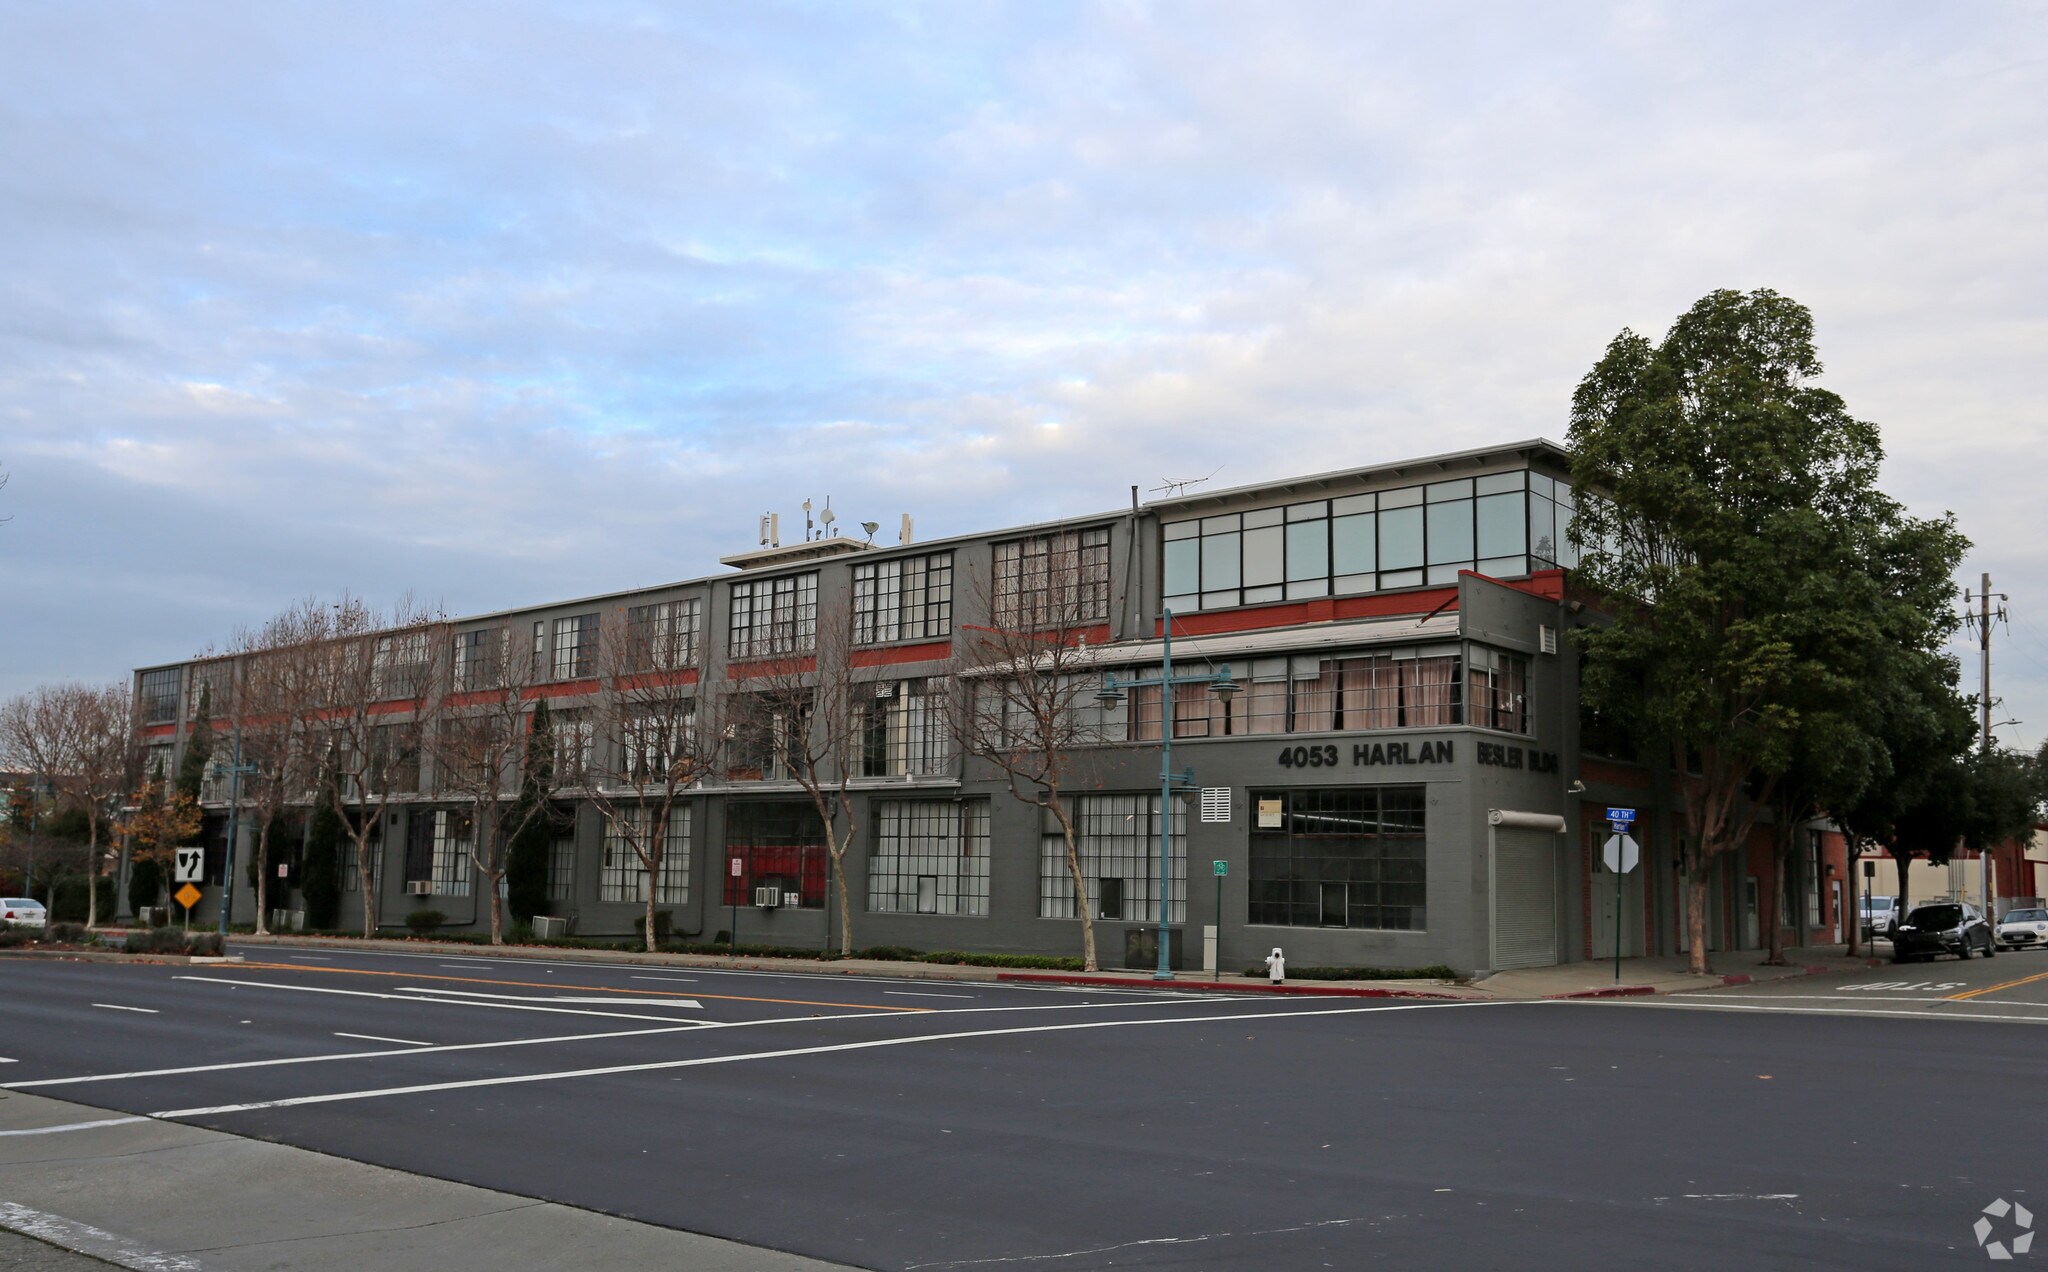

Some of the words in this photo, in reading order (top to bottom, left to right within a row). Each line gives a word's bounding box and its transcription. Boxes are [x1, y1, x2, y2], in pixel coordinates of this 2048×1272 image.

[1278, 744, 1339, 768] 4053
[1353, 740, 1454, 766] HARLAN
[1477, 741, 1523, 770] BESLER
[1610, 810, 1620, 818] 40
[1621, 811, 1629, 819] TH
[1836, 981, 1967, 991] STOP
